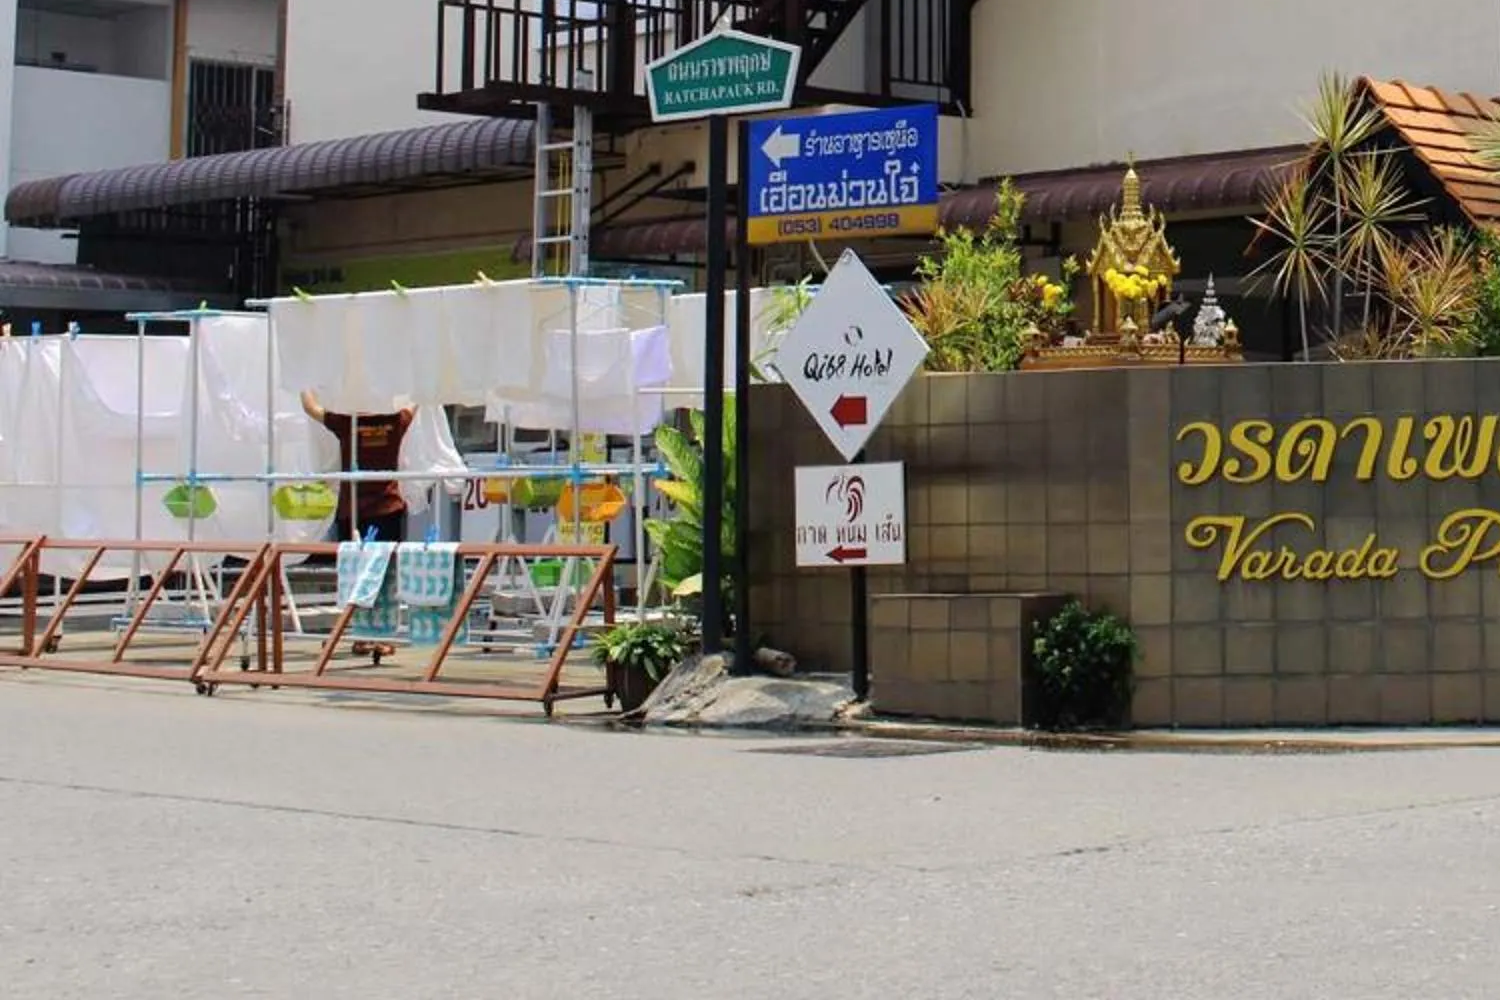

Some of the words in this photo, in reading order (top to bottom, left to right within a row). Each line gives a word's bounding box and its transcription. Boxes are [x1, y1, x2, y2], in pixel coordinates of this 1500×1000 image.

[778, 216, 822, 236] (053)
[849, 348, 893, 381] Hotel
[1185, 512, 1399, 581] Varada
